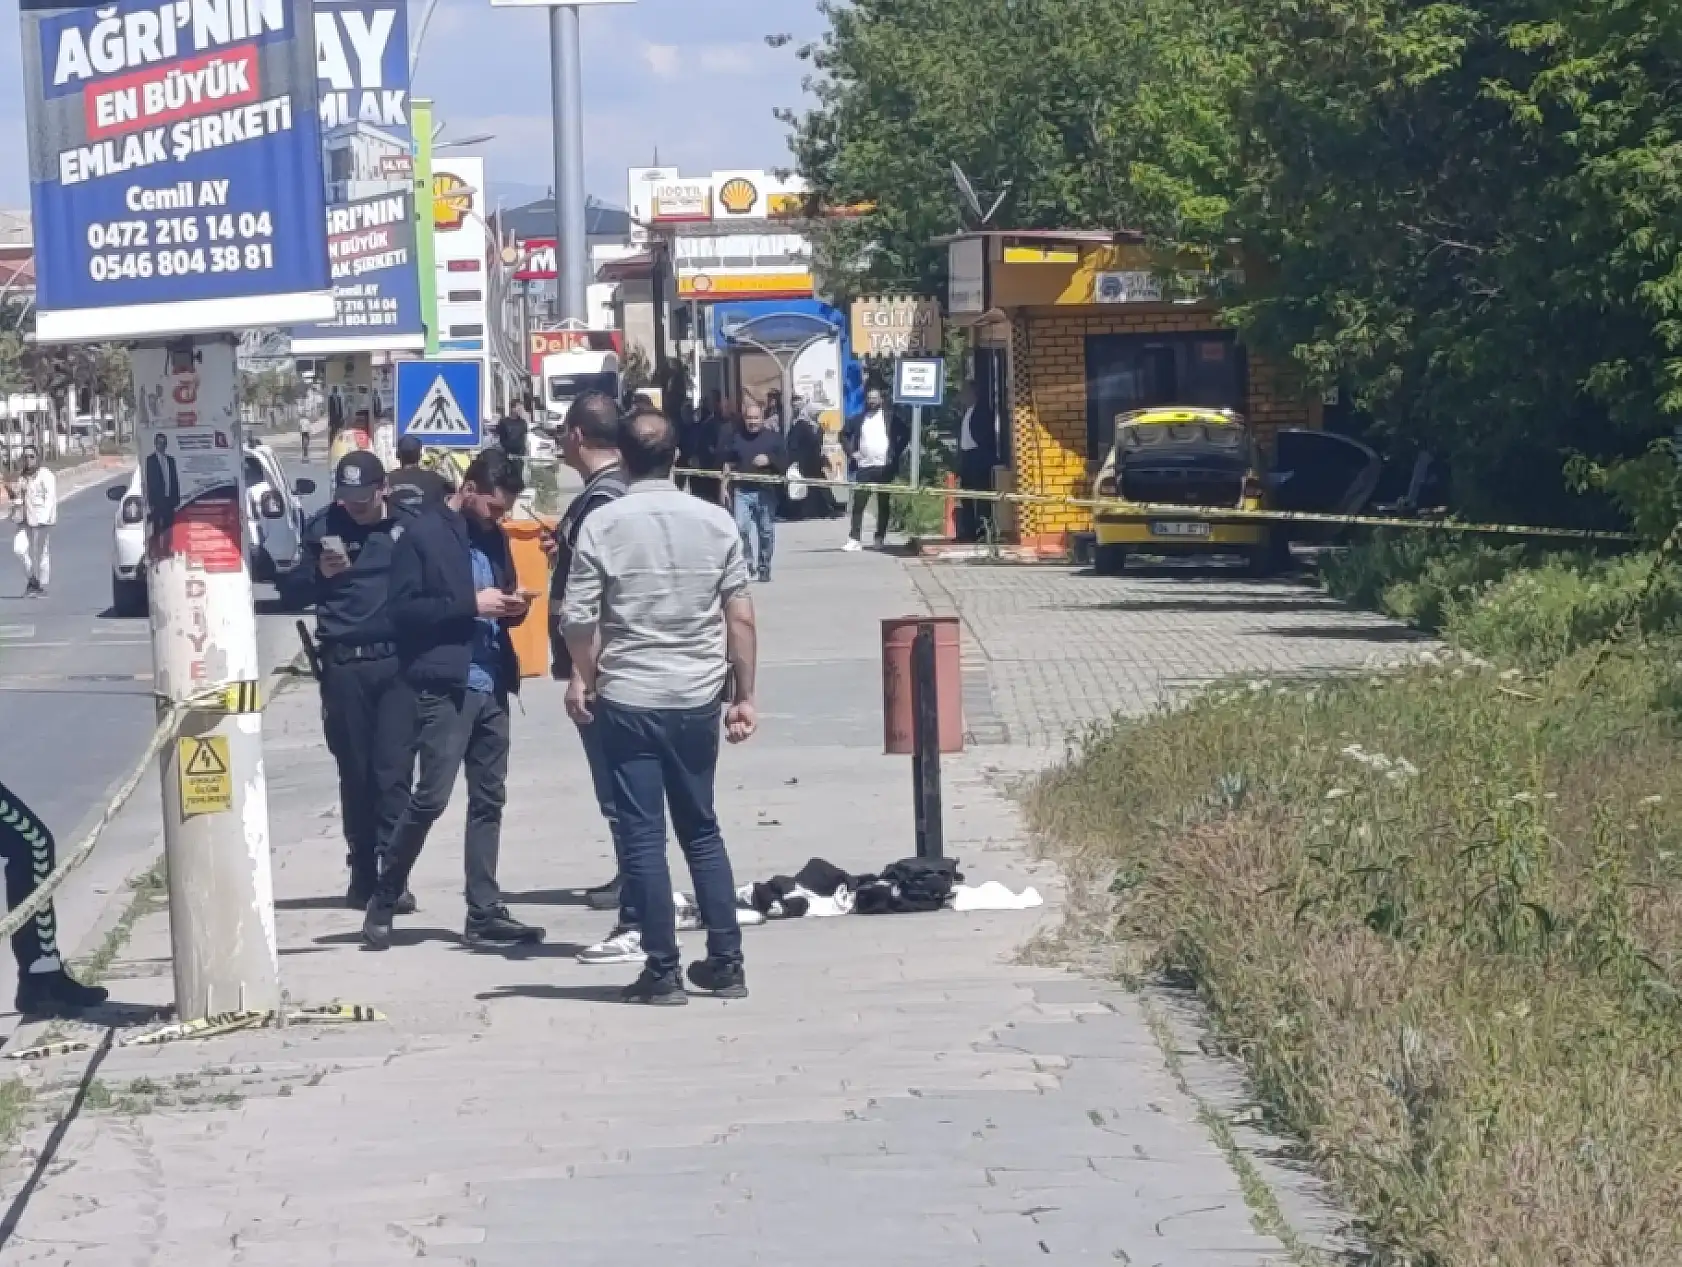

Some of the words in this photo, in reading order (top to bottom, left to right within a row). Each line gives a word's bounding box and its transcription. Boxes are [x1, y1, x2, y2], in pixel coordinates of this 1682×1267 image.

[314, 8, 397, 89] AY
[95, 87, 139, 128] EN
[143, 58, 251, 115] BÜYÜK
[59, 127, 168, 186] EMLAK
[172, 94, 292, 163] ŞİRKETİ
[126, 180, 194, 212] Cemil
[198, 178, 230, 207] AY
[87, 220, 149, 249] 0472
[155, 216, 199, 245] 216
[205, 213, 235, 241] 14
[239, 210, 274, 238] 04
[89, 252, 154, 282] 0546
[157, 248, 207, 277] 804
[210, 244, 241, 273] 38
[244, 243, 274, 269] 81
[862, 303, 934, 327] EĞİTİM
